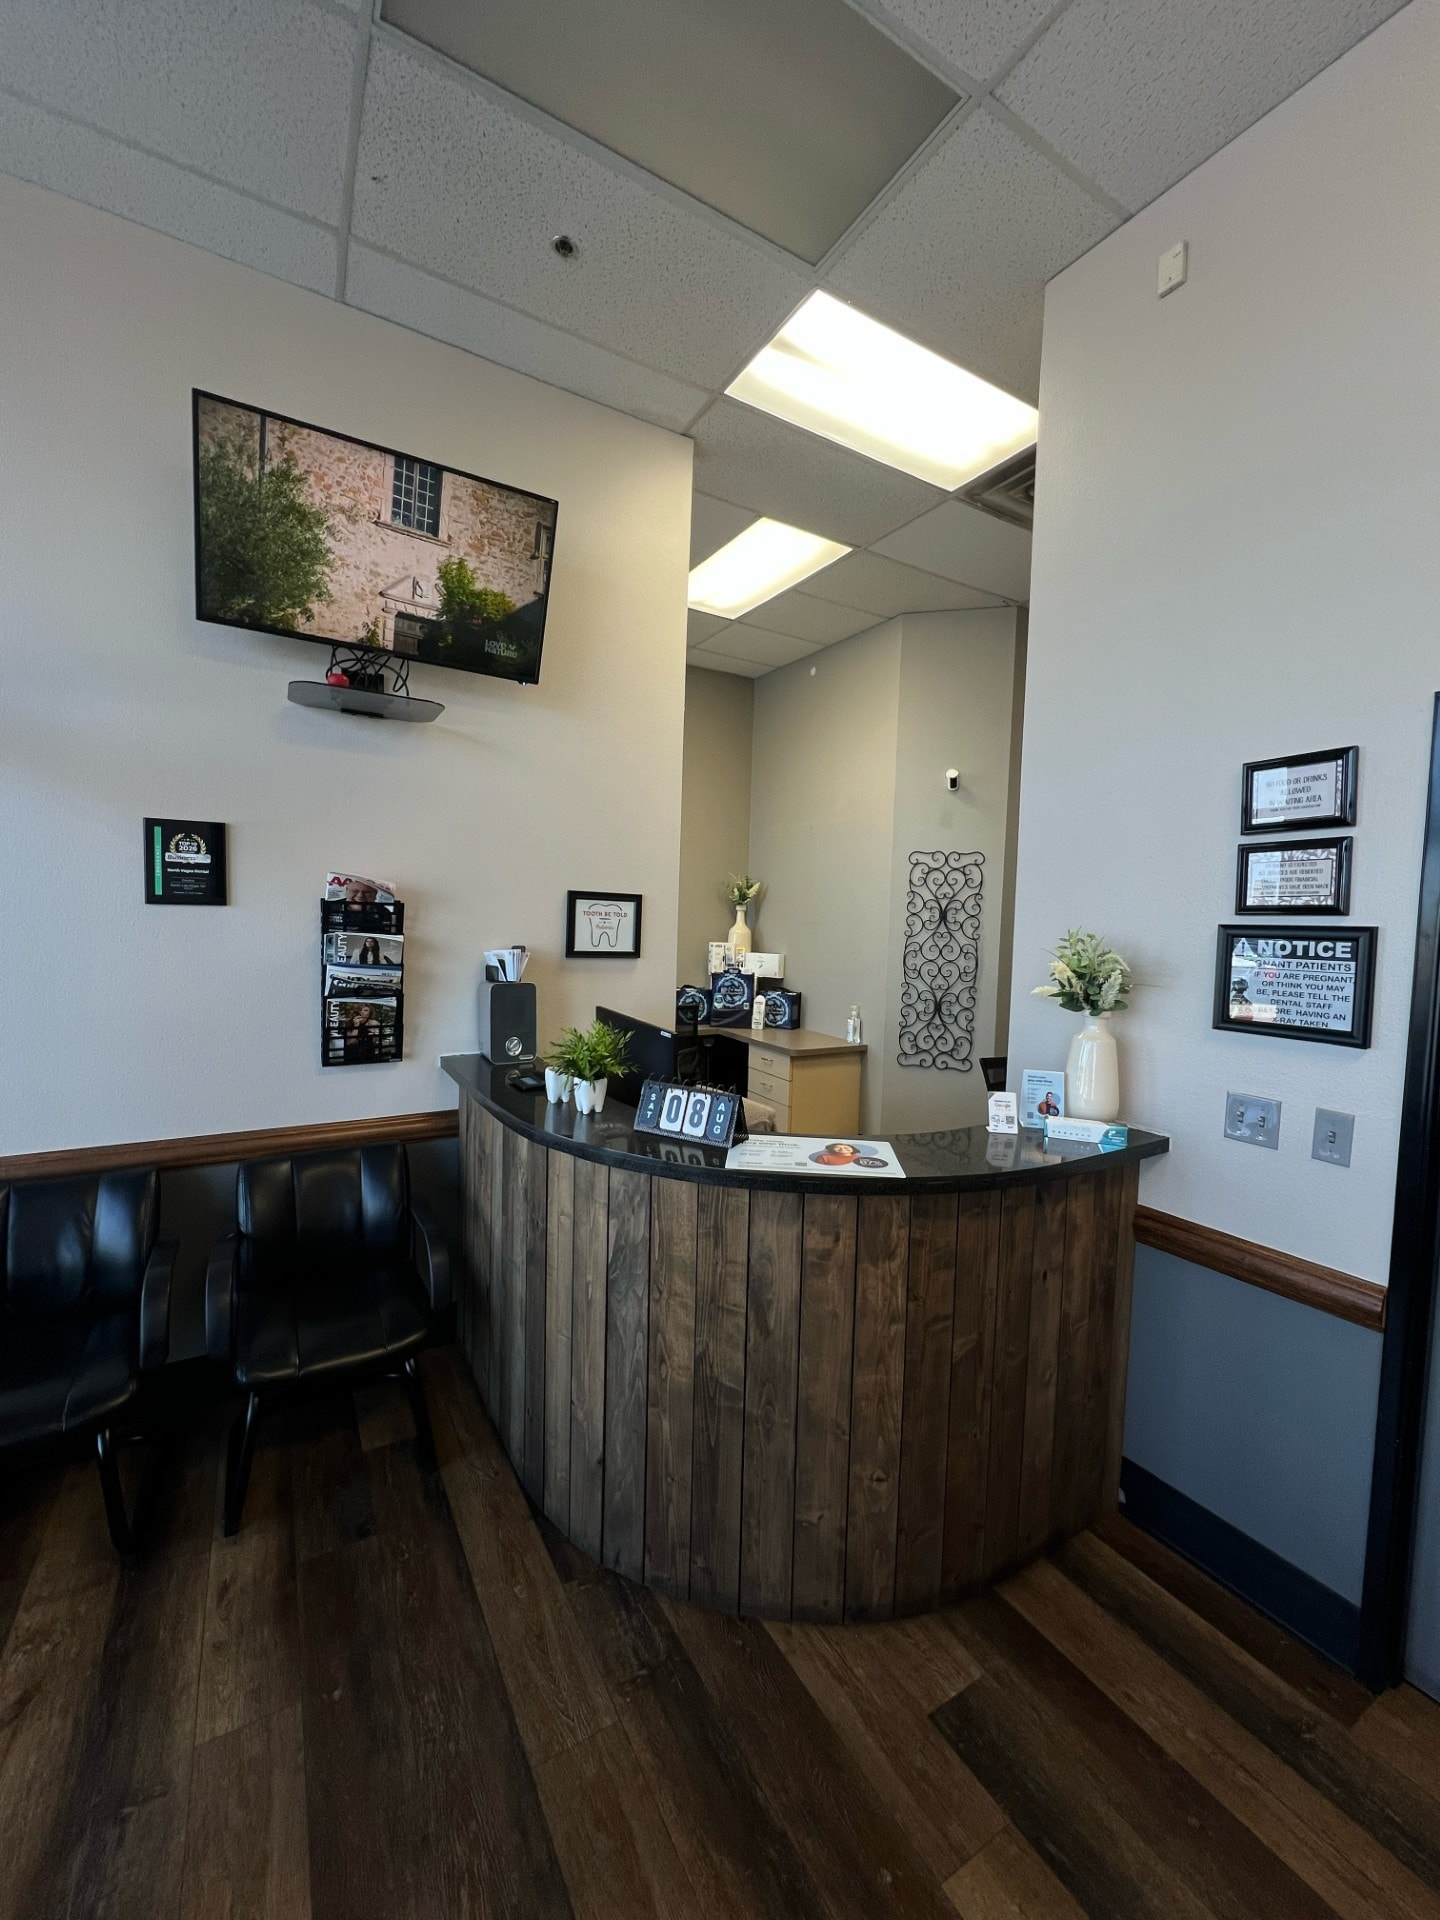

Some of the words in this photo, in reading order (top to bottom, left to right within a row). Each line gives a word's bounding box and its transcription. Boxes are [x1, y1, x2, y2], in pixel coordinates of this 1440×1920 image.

[1303, 773, 1328, 784] DRINKS
[337, 933, 348, 963] EAUTY
[1257, 939, 1353, 959] NOTICE
[1295, 960, 1353, 973] PATIENTS
[1263, 972, 1281, 980] YOU
[1282, 973, 1301, 981] ARE
[1276, 981, 1303, 990] THINK
[1304, 983, 1325, 992] YOU
[1326, 985, 1346, 993] MAY
[1256, 988, 1271, 996] BE,
[1271, 990, 1305, 1000] PLEASE
[1307, 992, 1331, 1001] TELL
[1332, 994, 1351, 1003] THE
[1270, 998, 1303, 1008] DENTAL
[1305, 1001, 1333, 1011] STAFF
[1295, 1009, 1331, 1020] HAVING
[1332, 1013, 1347, 1022] AN
[1299, 1019, 1329, 1029] TAKEN
[646, 1093, 657, 1119] SAT
[713, 1102, 726, 1135] AUG
